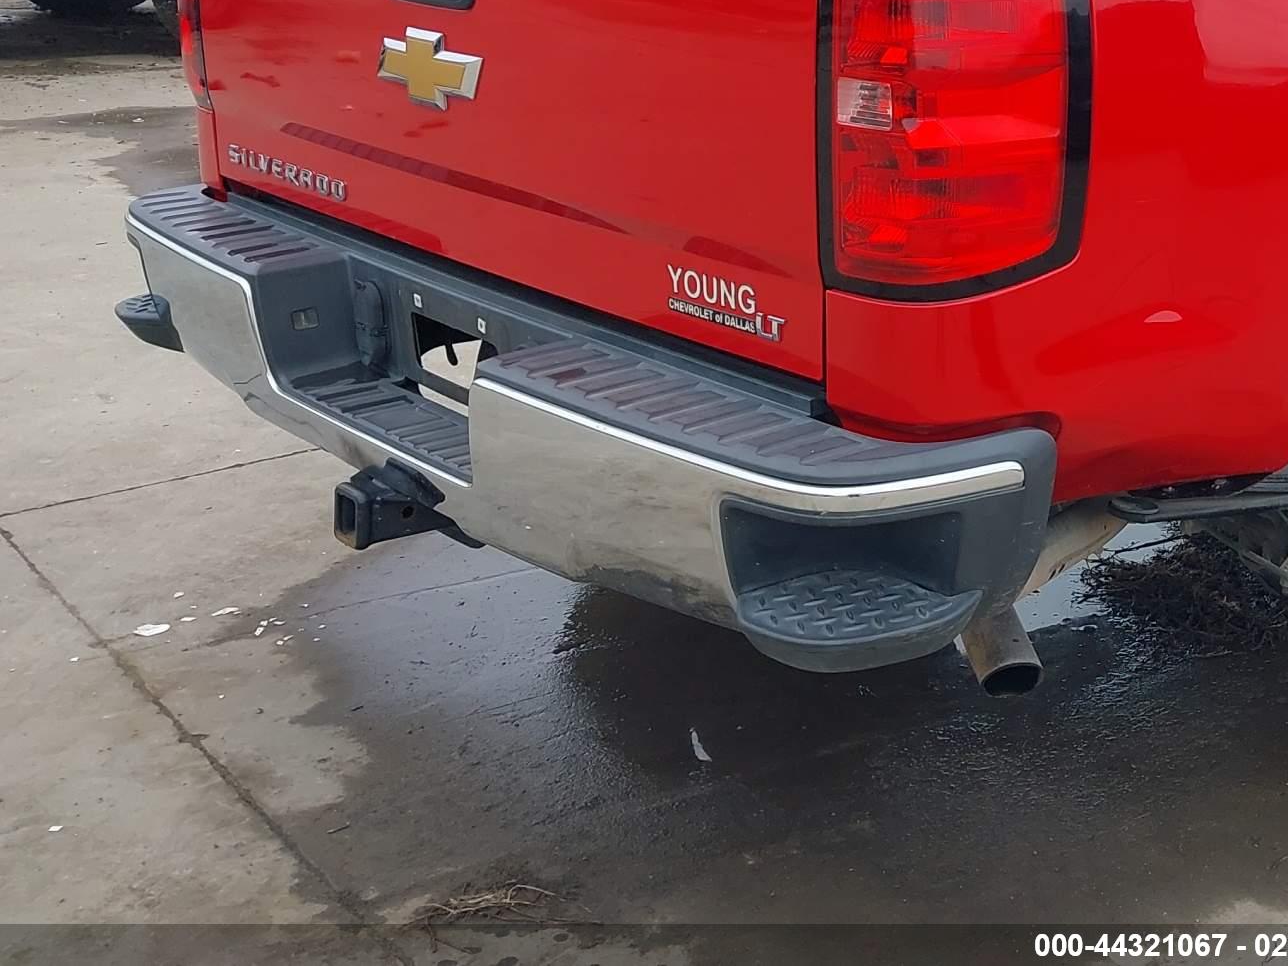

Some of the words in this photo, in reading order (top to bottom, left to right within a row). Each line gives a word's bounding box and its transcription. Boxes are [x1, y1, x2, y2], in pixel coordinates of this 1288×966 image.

[229, 144, 346, 200] SILVERADO
[667, 264, 756, 315] YOUNG
[668, 298, 714, 321] CHEVROLET
[714, 311, 724, 323] of
[724, 314, 756, 334] DALLAS
[755, 312, 786, 342] LT
